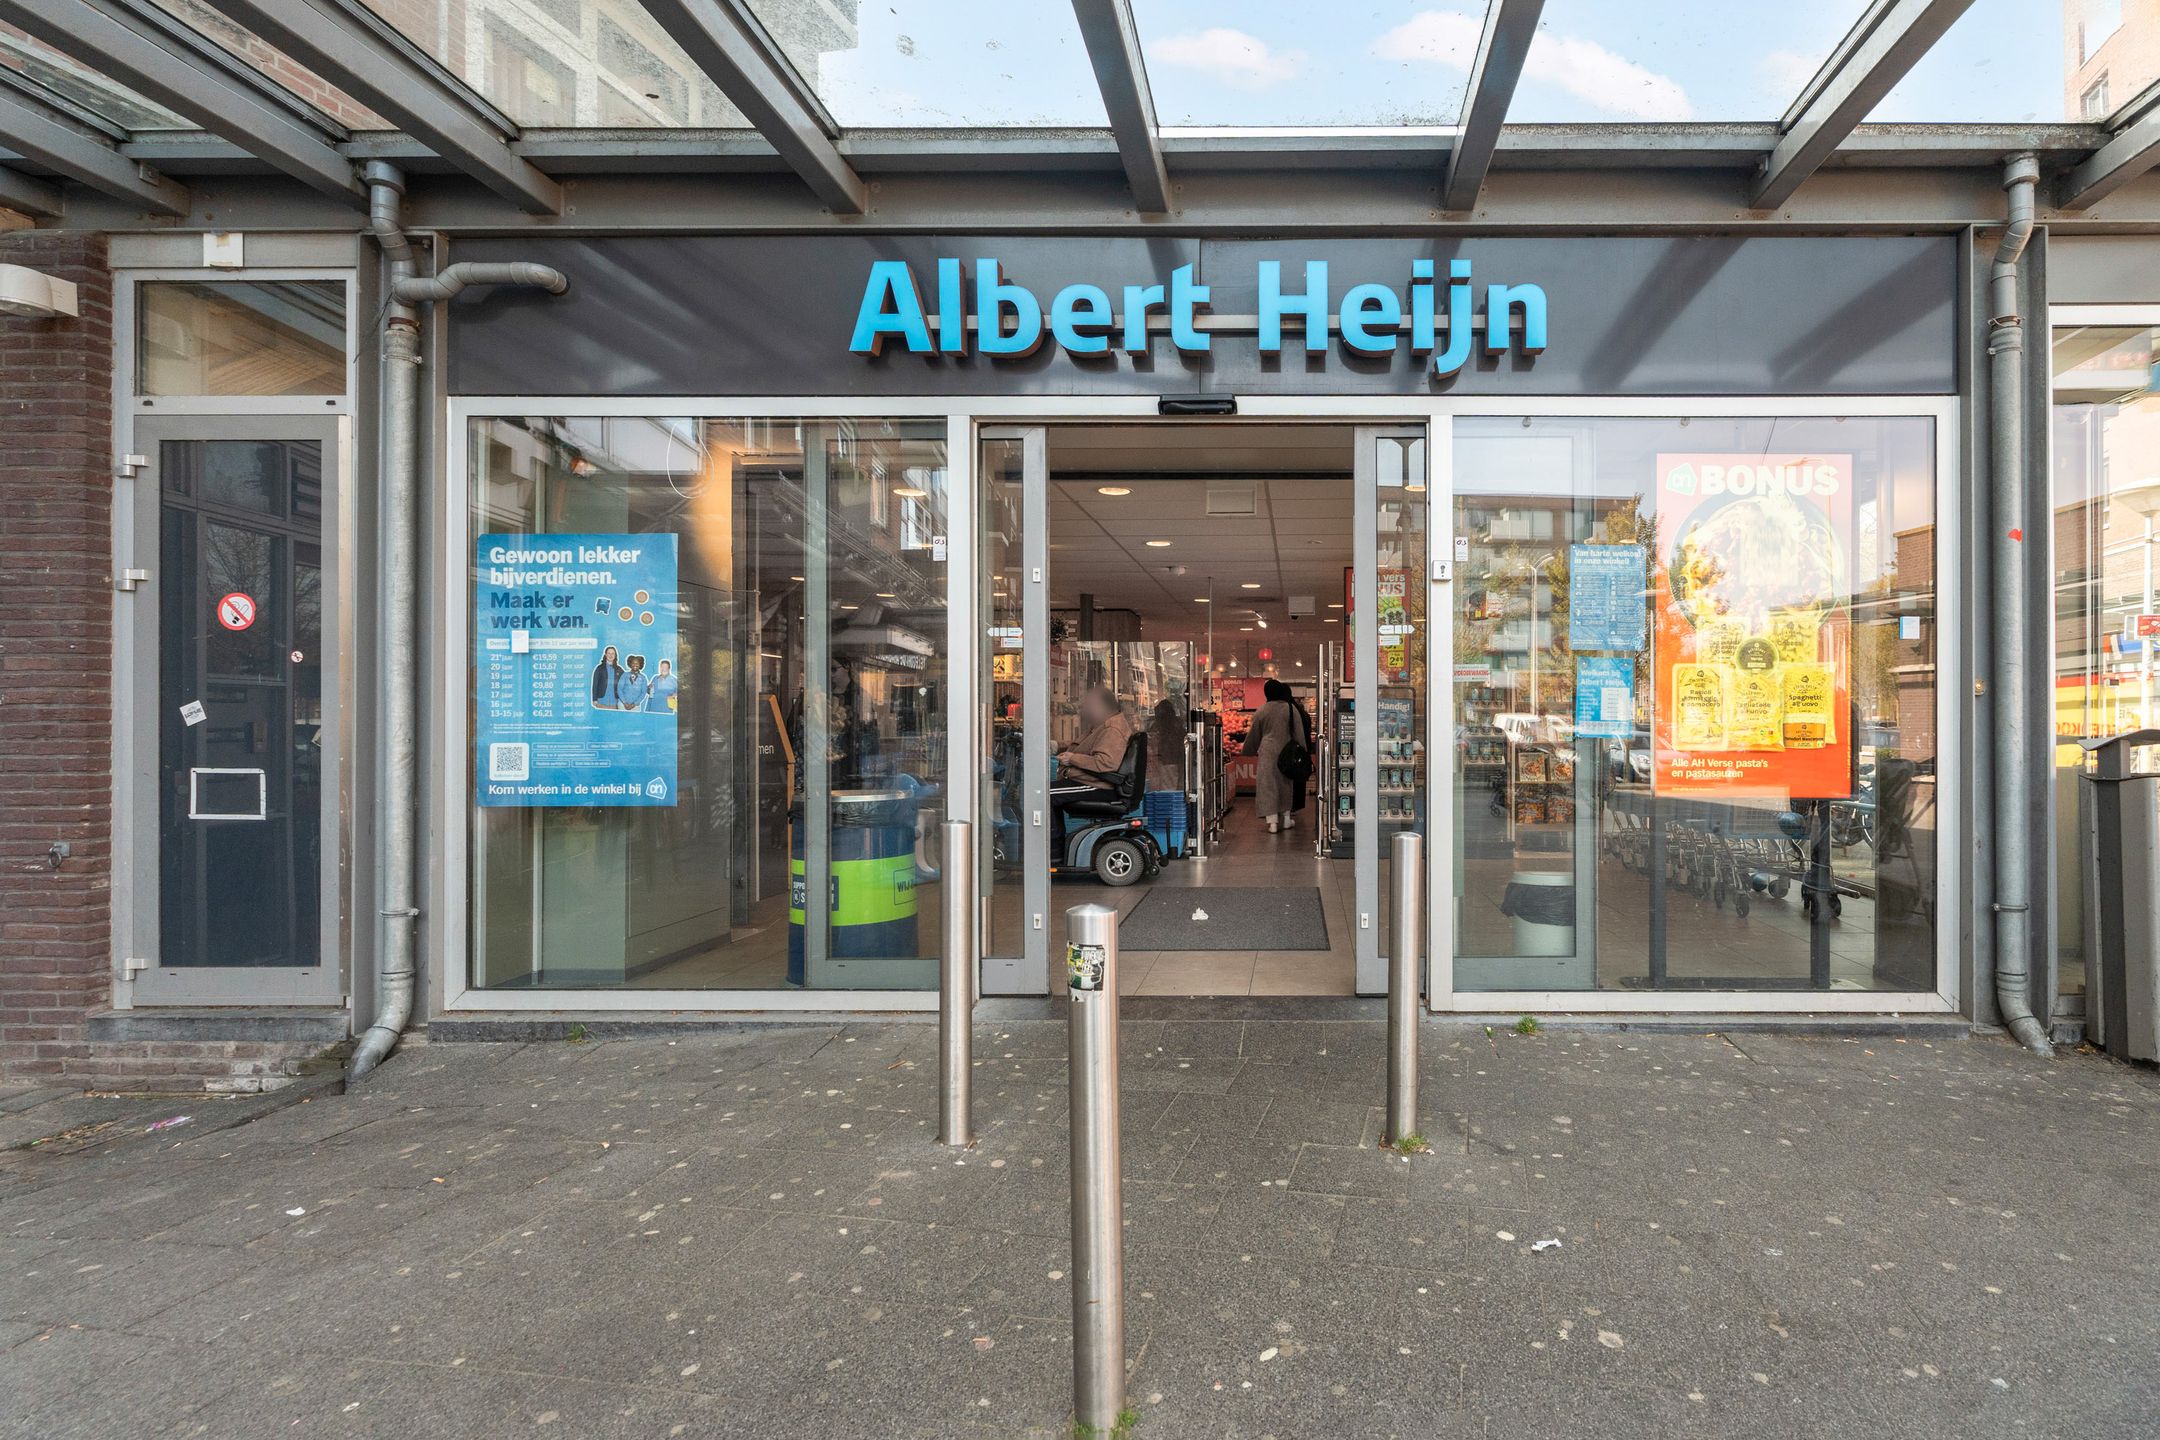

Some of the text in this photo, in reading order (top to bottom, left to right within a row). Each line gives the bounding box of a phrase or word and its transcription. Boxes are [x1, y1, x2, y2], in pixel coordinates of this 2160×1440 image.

[848, 257, 1549, 378] Albert Heijn
[1700, 464, 1840, 496] BONUS
[490, 546, 640, 564] Gewoon lekker
[490, 567, 617, 588] bijverdienen.
[490, 591, 574, 608] Maak er
[491, 611, 589, 628] werk van.
[1378, 701, 1409, 712] Handig!
[1672, 758, 1768, 769] Alle AH Verse pasta's
[1686, 769, 1743, 779] pastasauzen
[488, 784, 641, 796] Kom werken in de winkel bij
